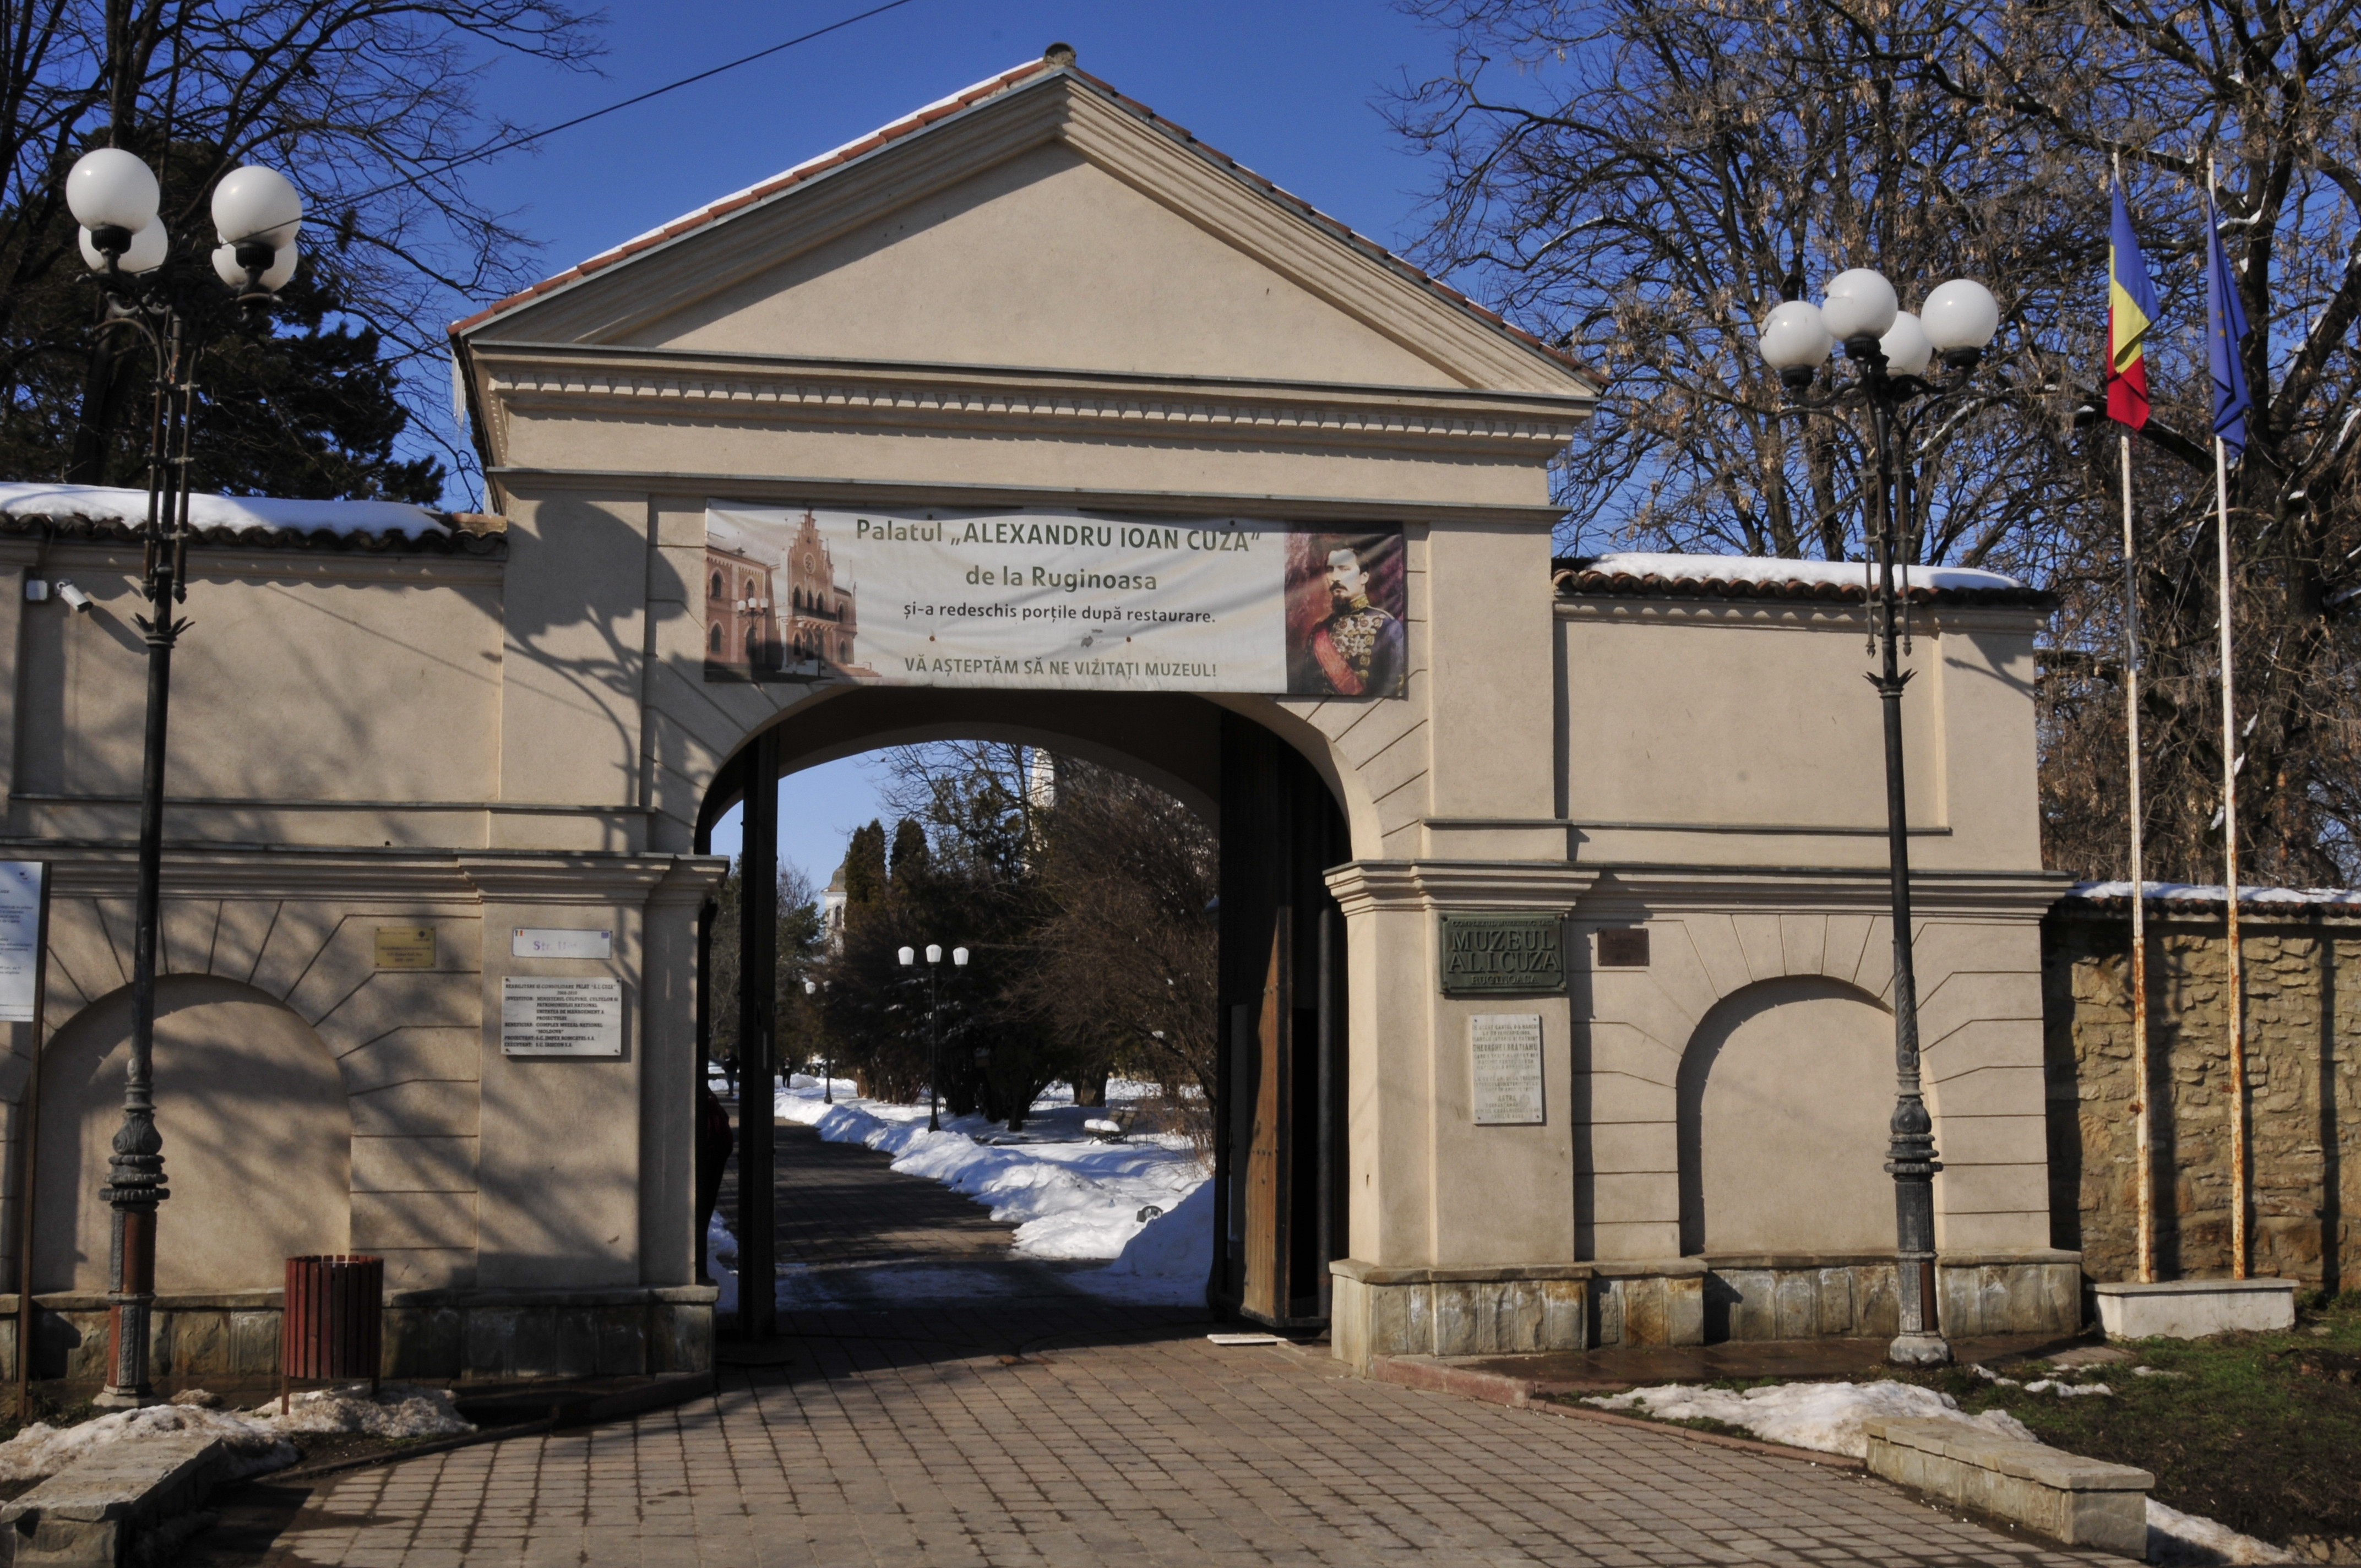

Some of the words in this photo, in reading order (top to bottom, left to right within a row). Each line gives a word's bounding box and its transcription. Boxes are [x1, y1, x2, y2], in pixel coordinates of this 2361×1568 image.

[856, 519, 942, 542] Palatul
[950, 522, 1112, 547] „ALEXANDRU
[1121, 527, 1178, 549] IOAN
[966, 565, 995, 586] de
[1003, 565, 1023, 586] la
[1032, 566, 1156, 592] Ruginoasa
[904, 601, 934, 620] și-a
[939, 603, 1017, 617] redeschis
[1022, 605, 1077, 623] porțile
[1081, 606, 1122, 623] după
[1127, 608, 1216, 623] restaurare.
[905, 654, 927, 672] VĂ
[932, 655, 1019, 677] AȘTEPTĂM
[1024, 657, 1045, 674] SĂ
[1049, 661, 1070, 675] NE
[1145, 662, 1217, 677] MUZEUL!
[1450, 930, 1557, 952] MUZEUL
[1499, 951, 1563, 973] CUZA
[1471, 974, 1540, 985] RUGINOASA
